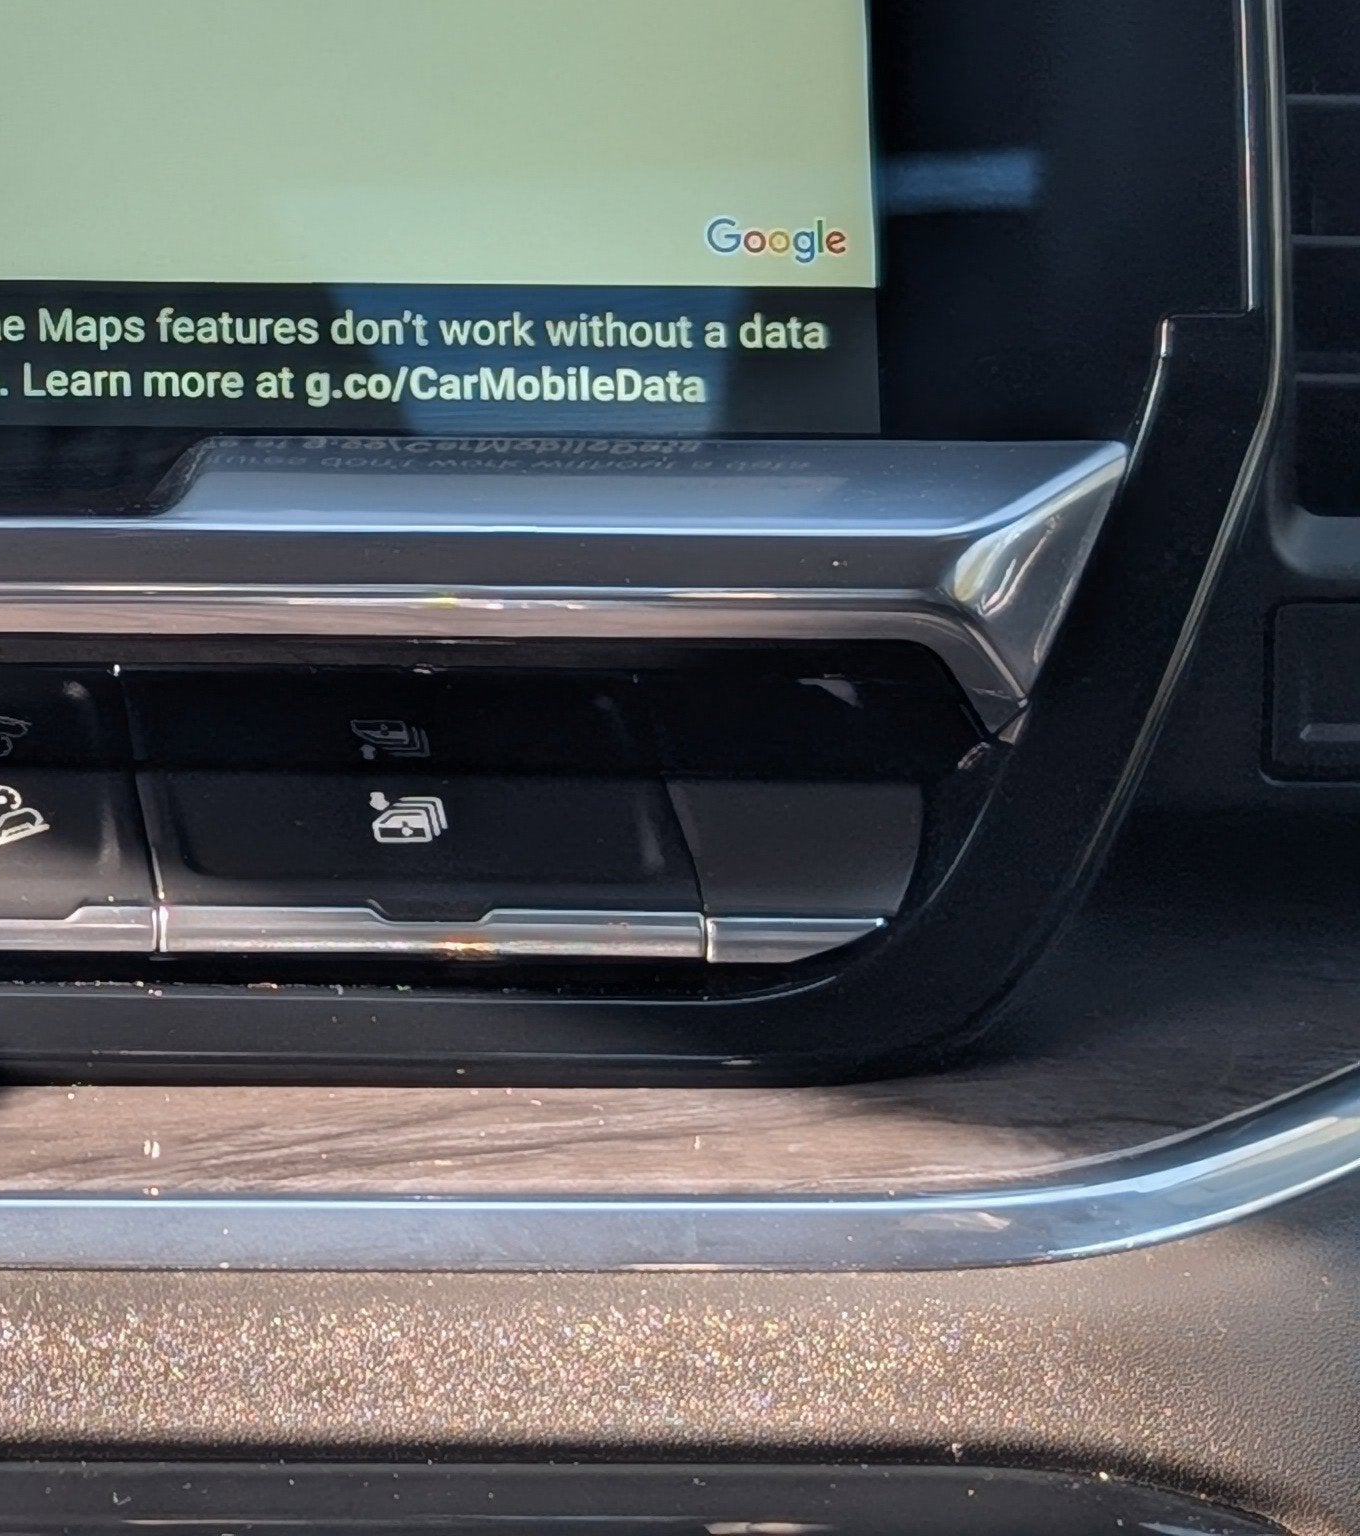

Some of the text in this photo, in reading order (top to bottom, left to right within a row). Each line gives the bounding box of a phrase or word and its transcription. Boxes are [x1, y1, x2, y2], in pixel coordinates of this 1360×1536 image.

[707, 218, 846, 263] Google
[38, 307, 146, 351] Maps
[155, 307, 320, 345] features
[438, 311, 535, 347] work
[545, 311, 694, 349] without
[704, 321, 728, 349] a
[739, 312, 828, 350] data
[23, 362, 132, 397] Learn
[143, 371, 245, 399] more
[255, 366, 295, 399] at
[305, 365, 707, 407] g.co/CarMobileData
